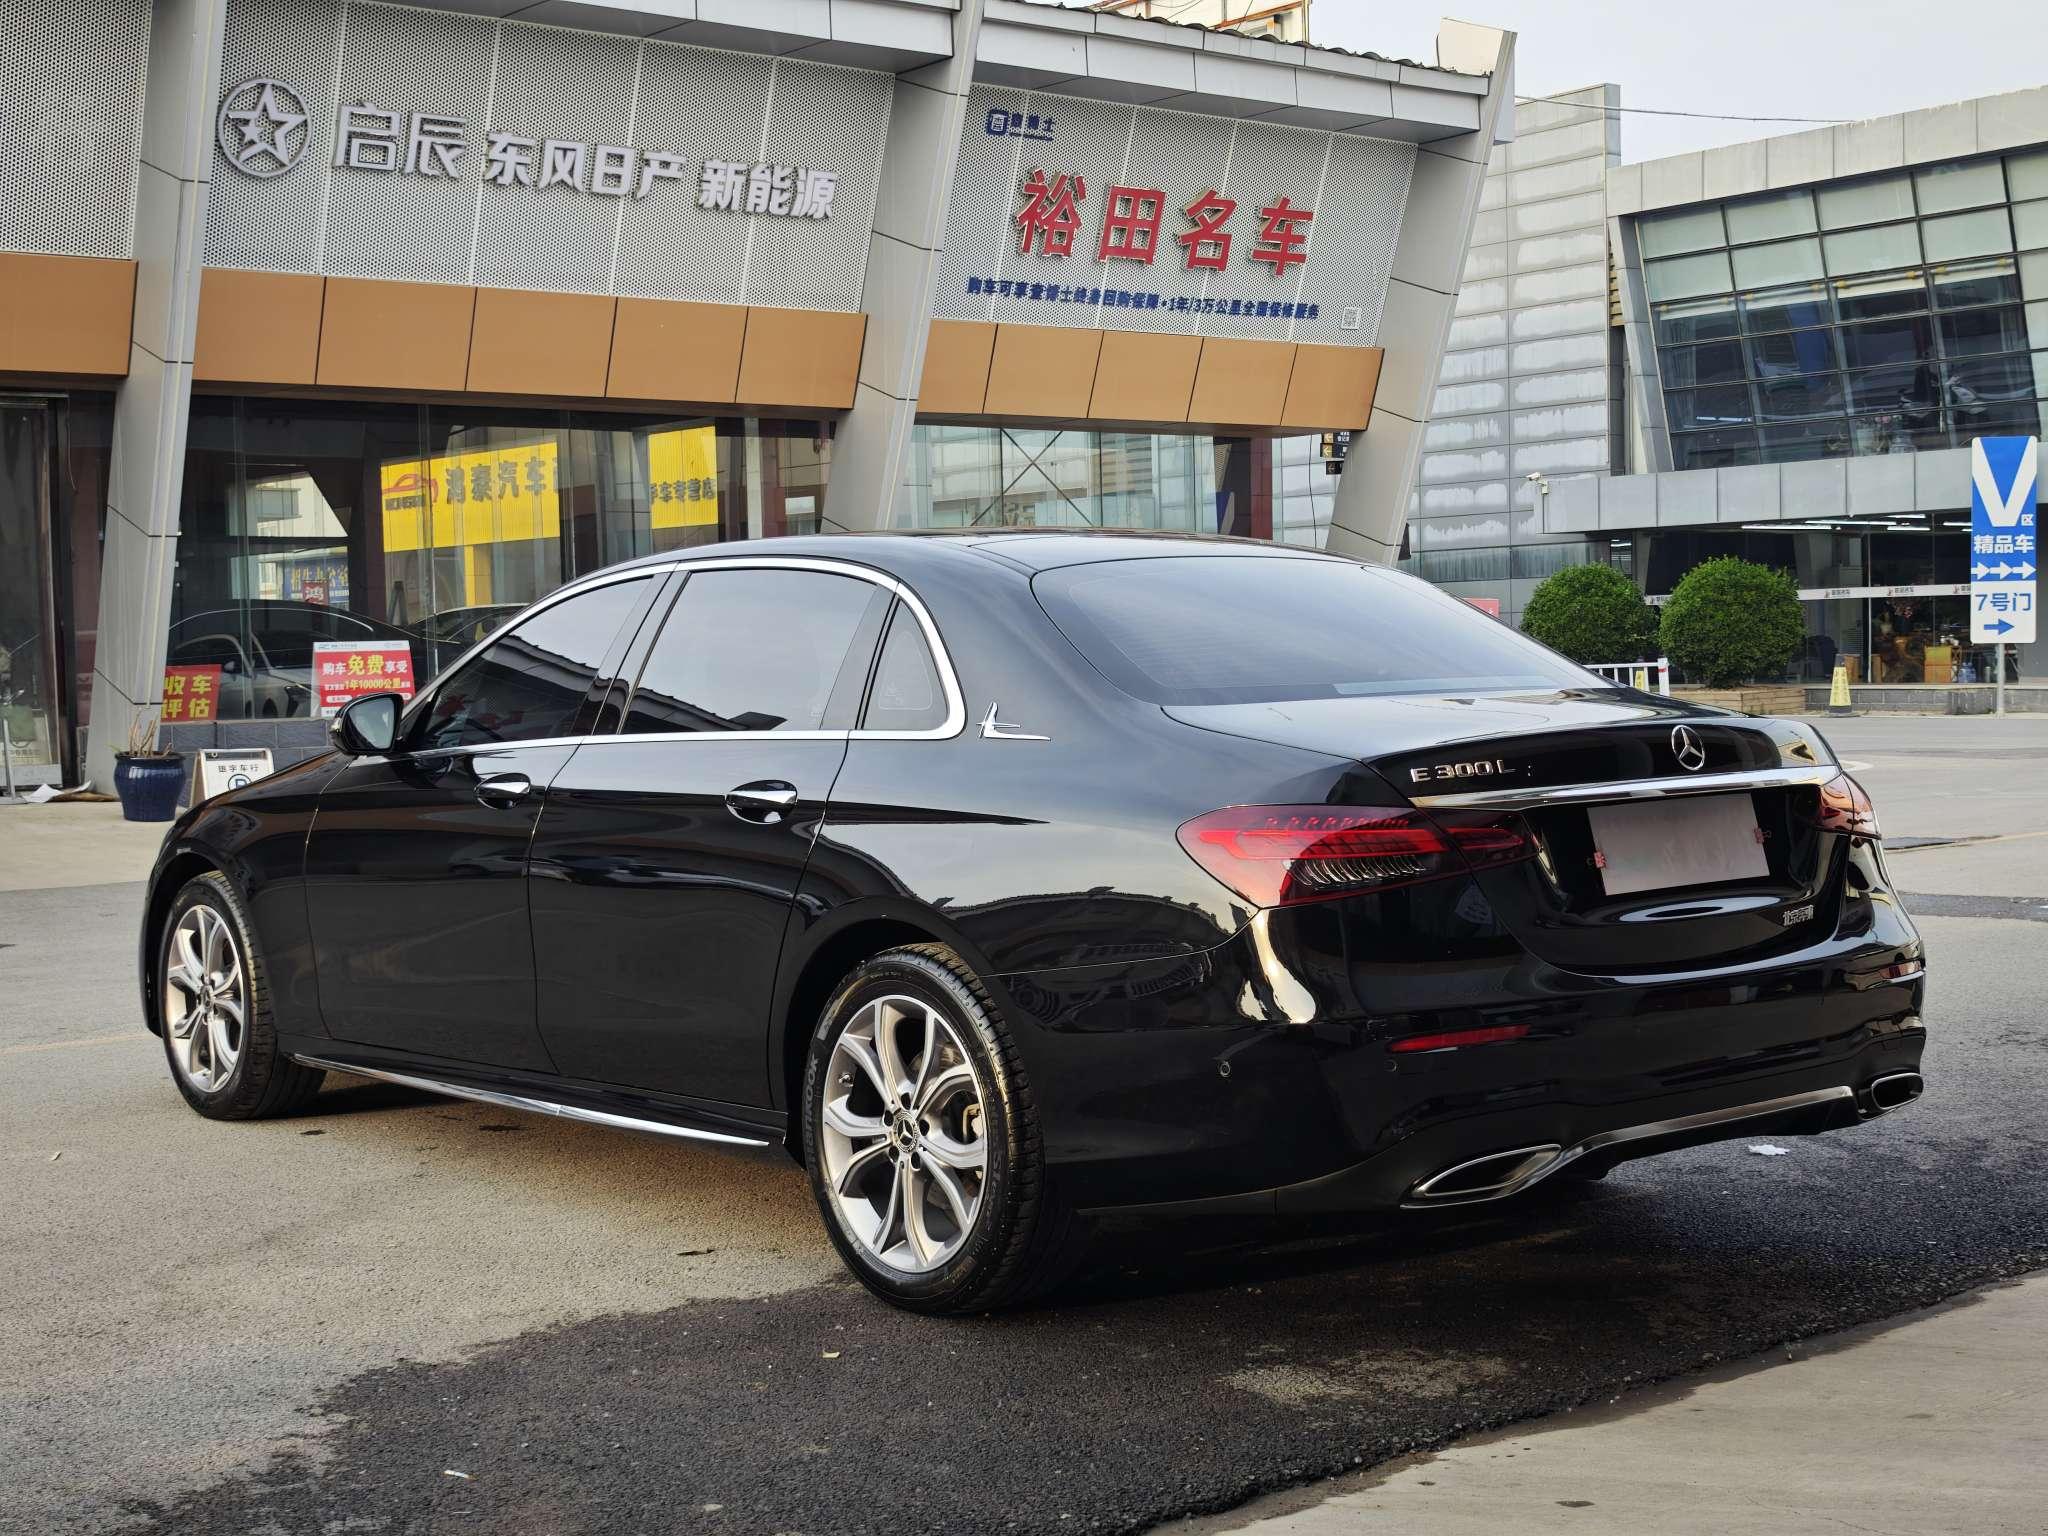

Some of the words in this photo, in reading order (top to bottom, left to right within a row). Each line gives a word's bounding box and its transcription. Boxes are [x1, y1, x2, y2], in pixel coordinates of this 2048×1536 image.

[334, 101, 470, 179] 启辰
[485, 132, 686, 201] 东风日产
[698, 158, 839, 220] 新能源
[1016, 167, 1313, 277] 裕田名车
[1973, 534, 2035, 555] 精品车
[1975, 592, 2032, 612] 7号门
[322, 655, 408, 676] 购车免费享受
